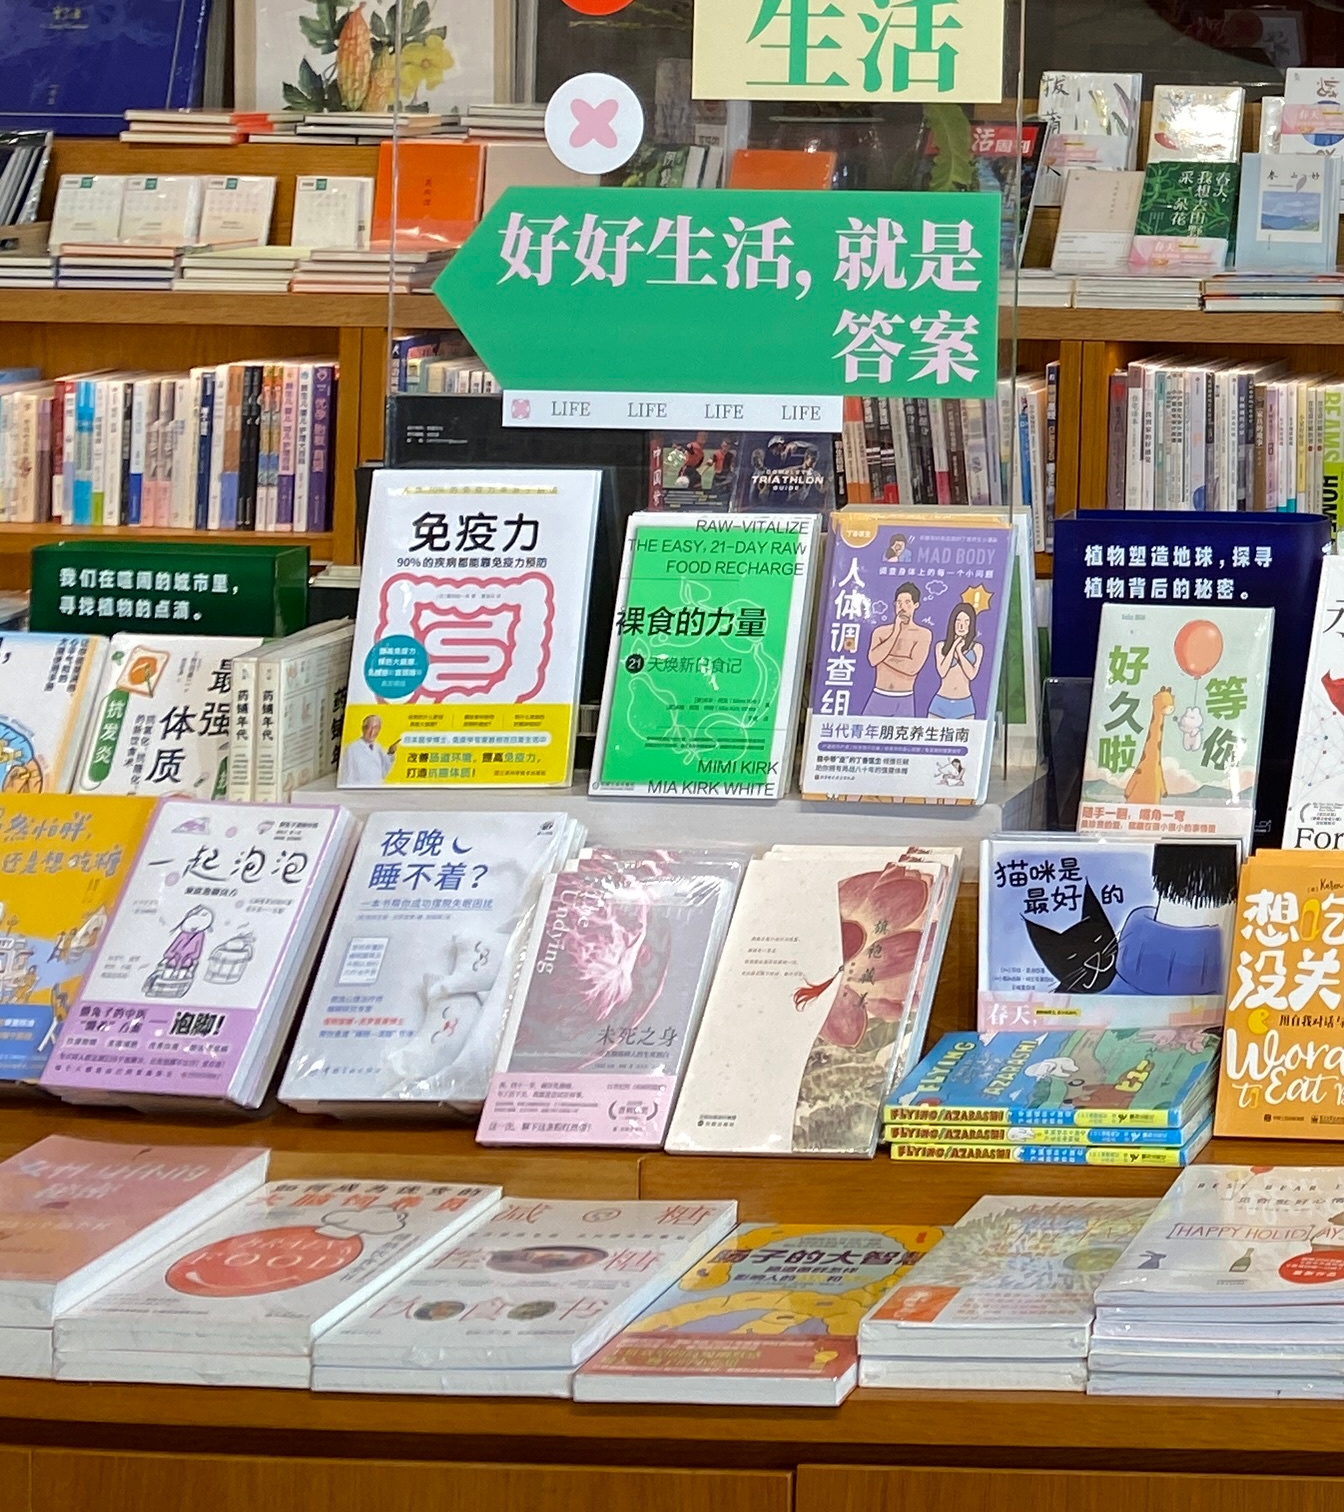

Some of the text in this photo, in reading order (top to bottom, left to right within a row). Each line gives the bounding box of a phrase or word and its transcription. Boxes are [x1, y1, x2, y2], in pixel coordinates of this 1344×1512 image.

[497, 211, 984, 302] 好好生活，就是
[831, 308, 982, 386] 答案
[551, 400, 822, 422] LIFE LIFE LIFE LIFE
[750, 474, 825, 486] TRIATHLON
[408, 510, 540, 554] 免疫力
[629, 538, 658, 553] THE
[770, 540, 808, 556] RAW
[917, 546, 996, 567] MAD BODY
[1083, 544, 1275, 570] 植物塑造地球，探寻
[666, 560, 805, 576] FOOD RECHARGE
[1083, 577, 1251, 601] 植物背后的秘密。
[615, 605, 767, 639] 裸食的力量
[820, 556, 868, 717] 人体调查组
[1098, 644, 1150, 775] 好久啦
[820, 721, 970, 743] 当代青年朋克养生指南
[1200, 675, 1249, 773] 等你
[698, 760, 778, 776] MIMI KIRK
[646, 779, 775, 797] MIA KIRK WHITE
[381, 828, 446, 858] 夜晚
[368, 862, 490, 892] 睡不着？
[993, 856, 1083, 888] 猫咪是
[1023, 883, 1125, 914] 最好的
[597, 1025, 680, 1047] 未死之身
